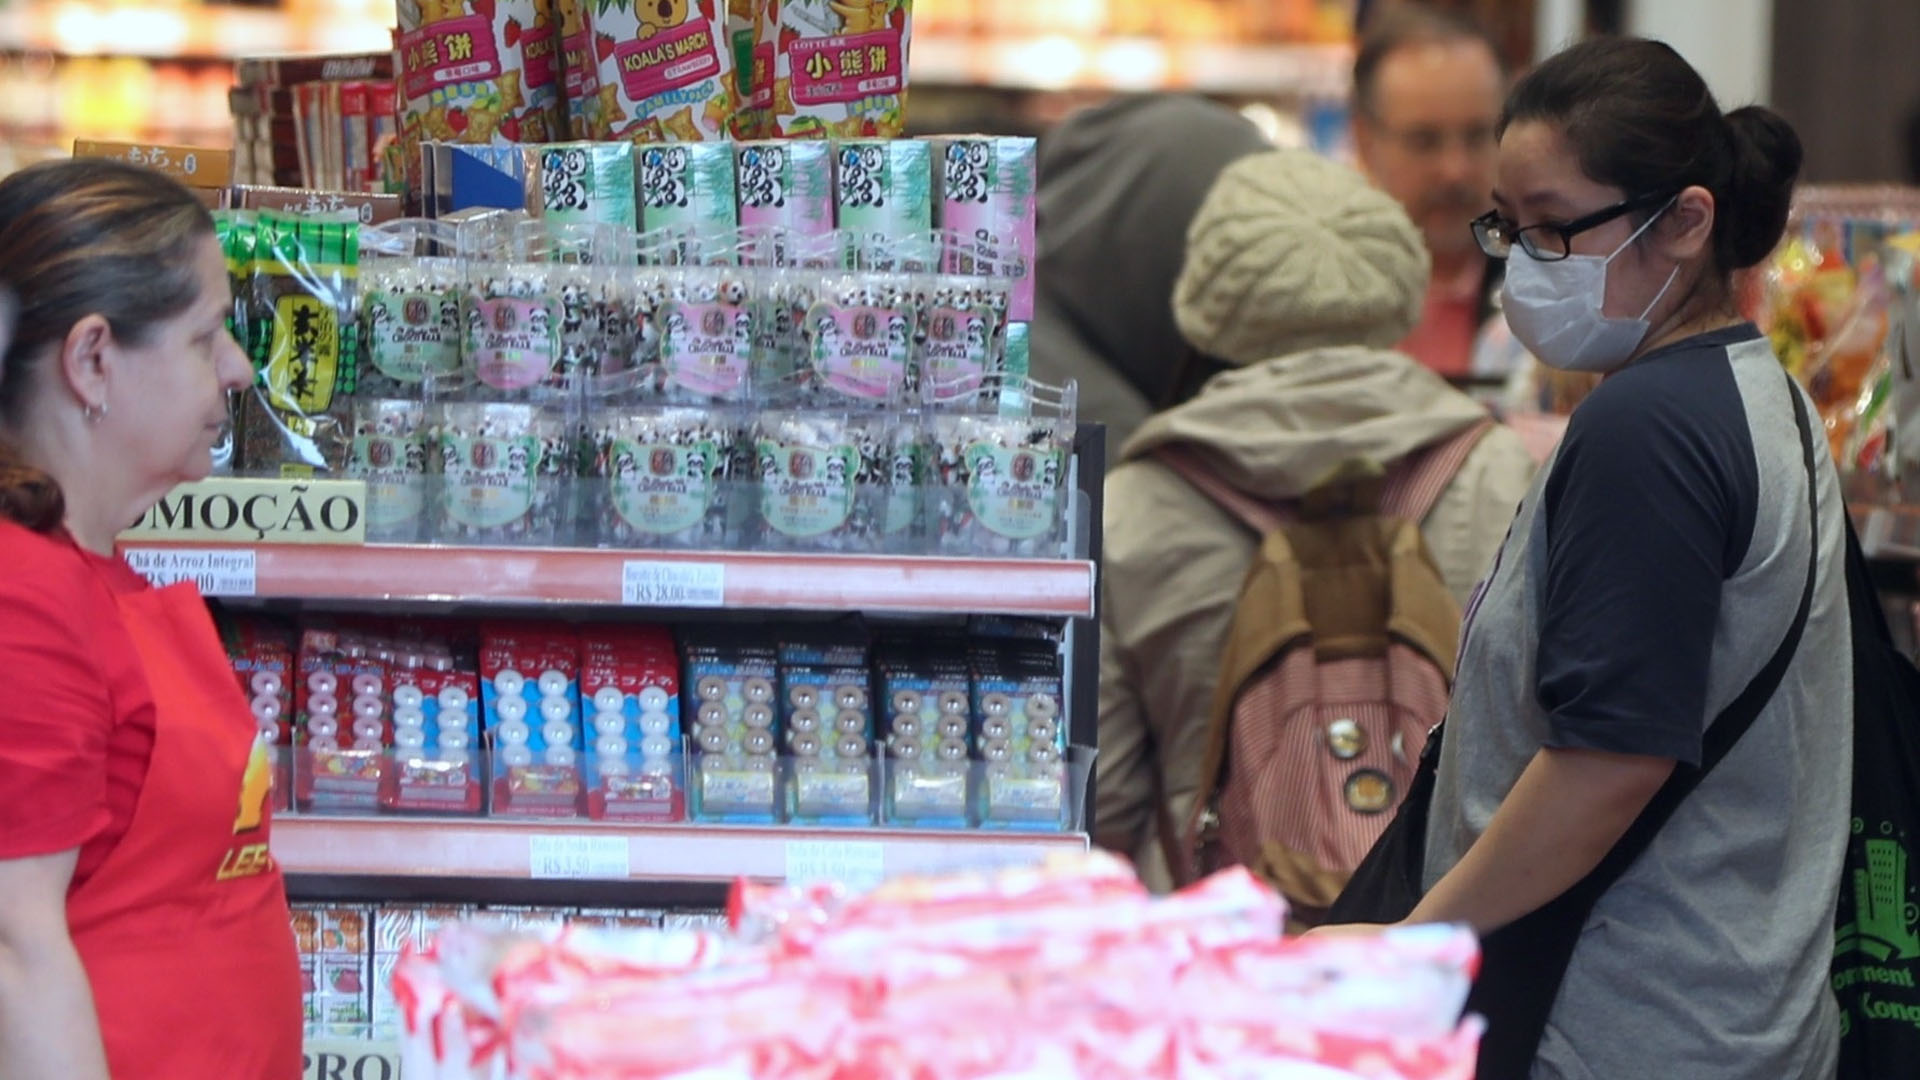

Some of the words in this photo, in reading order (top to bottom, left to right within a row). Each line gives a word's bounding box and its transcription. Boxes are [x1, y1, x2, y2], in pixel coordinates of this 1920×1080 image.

[624, 42, 675, 72] KOALA'S
[675, 31, 708, 57] MARCH
[794, 40, 827, 50] LOTTE
[804, 45, 888, 80] 小熊饼
[126, 551, 150, 568] Chá
[153, 552, 167, 568] de
[170, 554, 204, 569] Arroz
[207, 553, 255, 572] Integral
